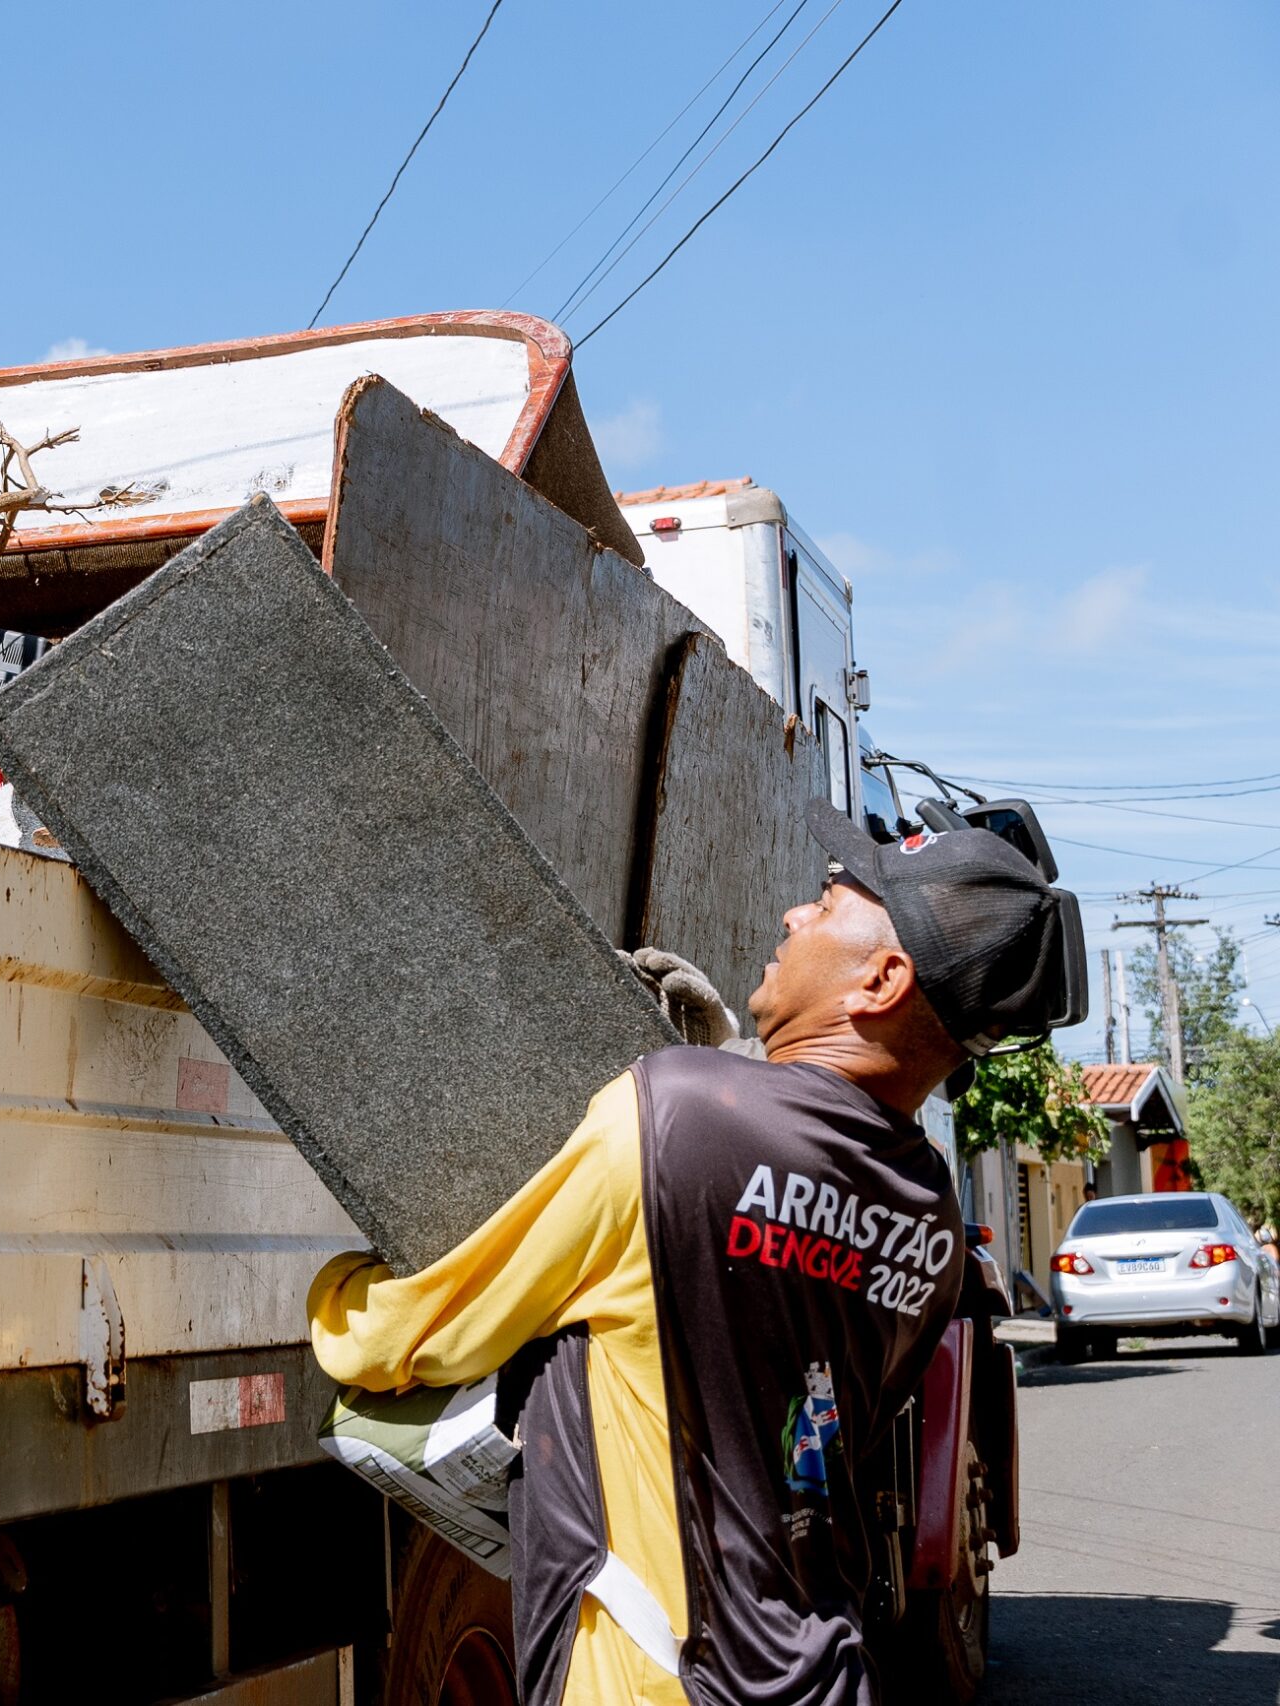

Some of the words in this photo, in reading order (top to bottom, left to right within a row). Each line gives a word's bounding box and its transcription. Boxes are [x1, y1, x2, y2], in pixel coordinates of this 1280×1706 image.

[726, 1215, 863, 1291] DENGUE
[867, 1264, 937, 1316] 2022
[736, 1164, 954, 1275] ARRASTÃO
